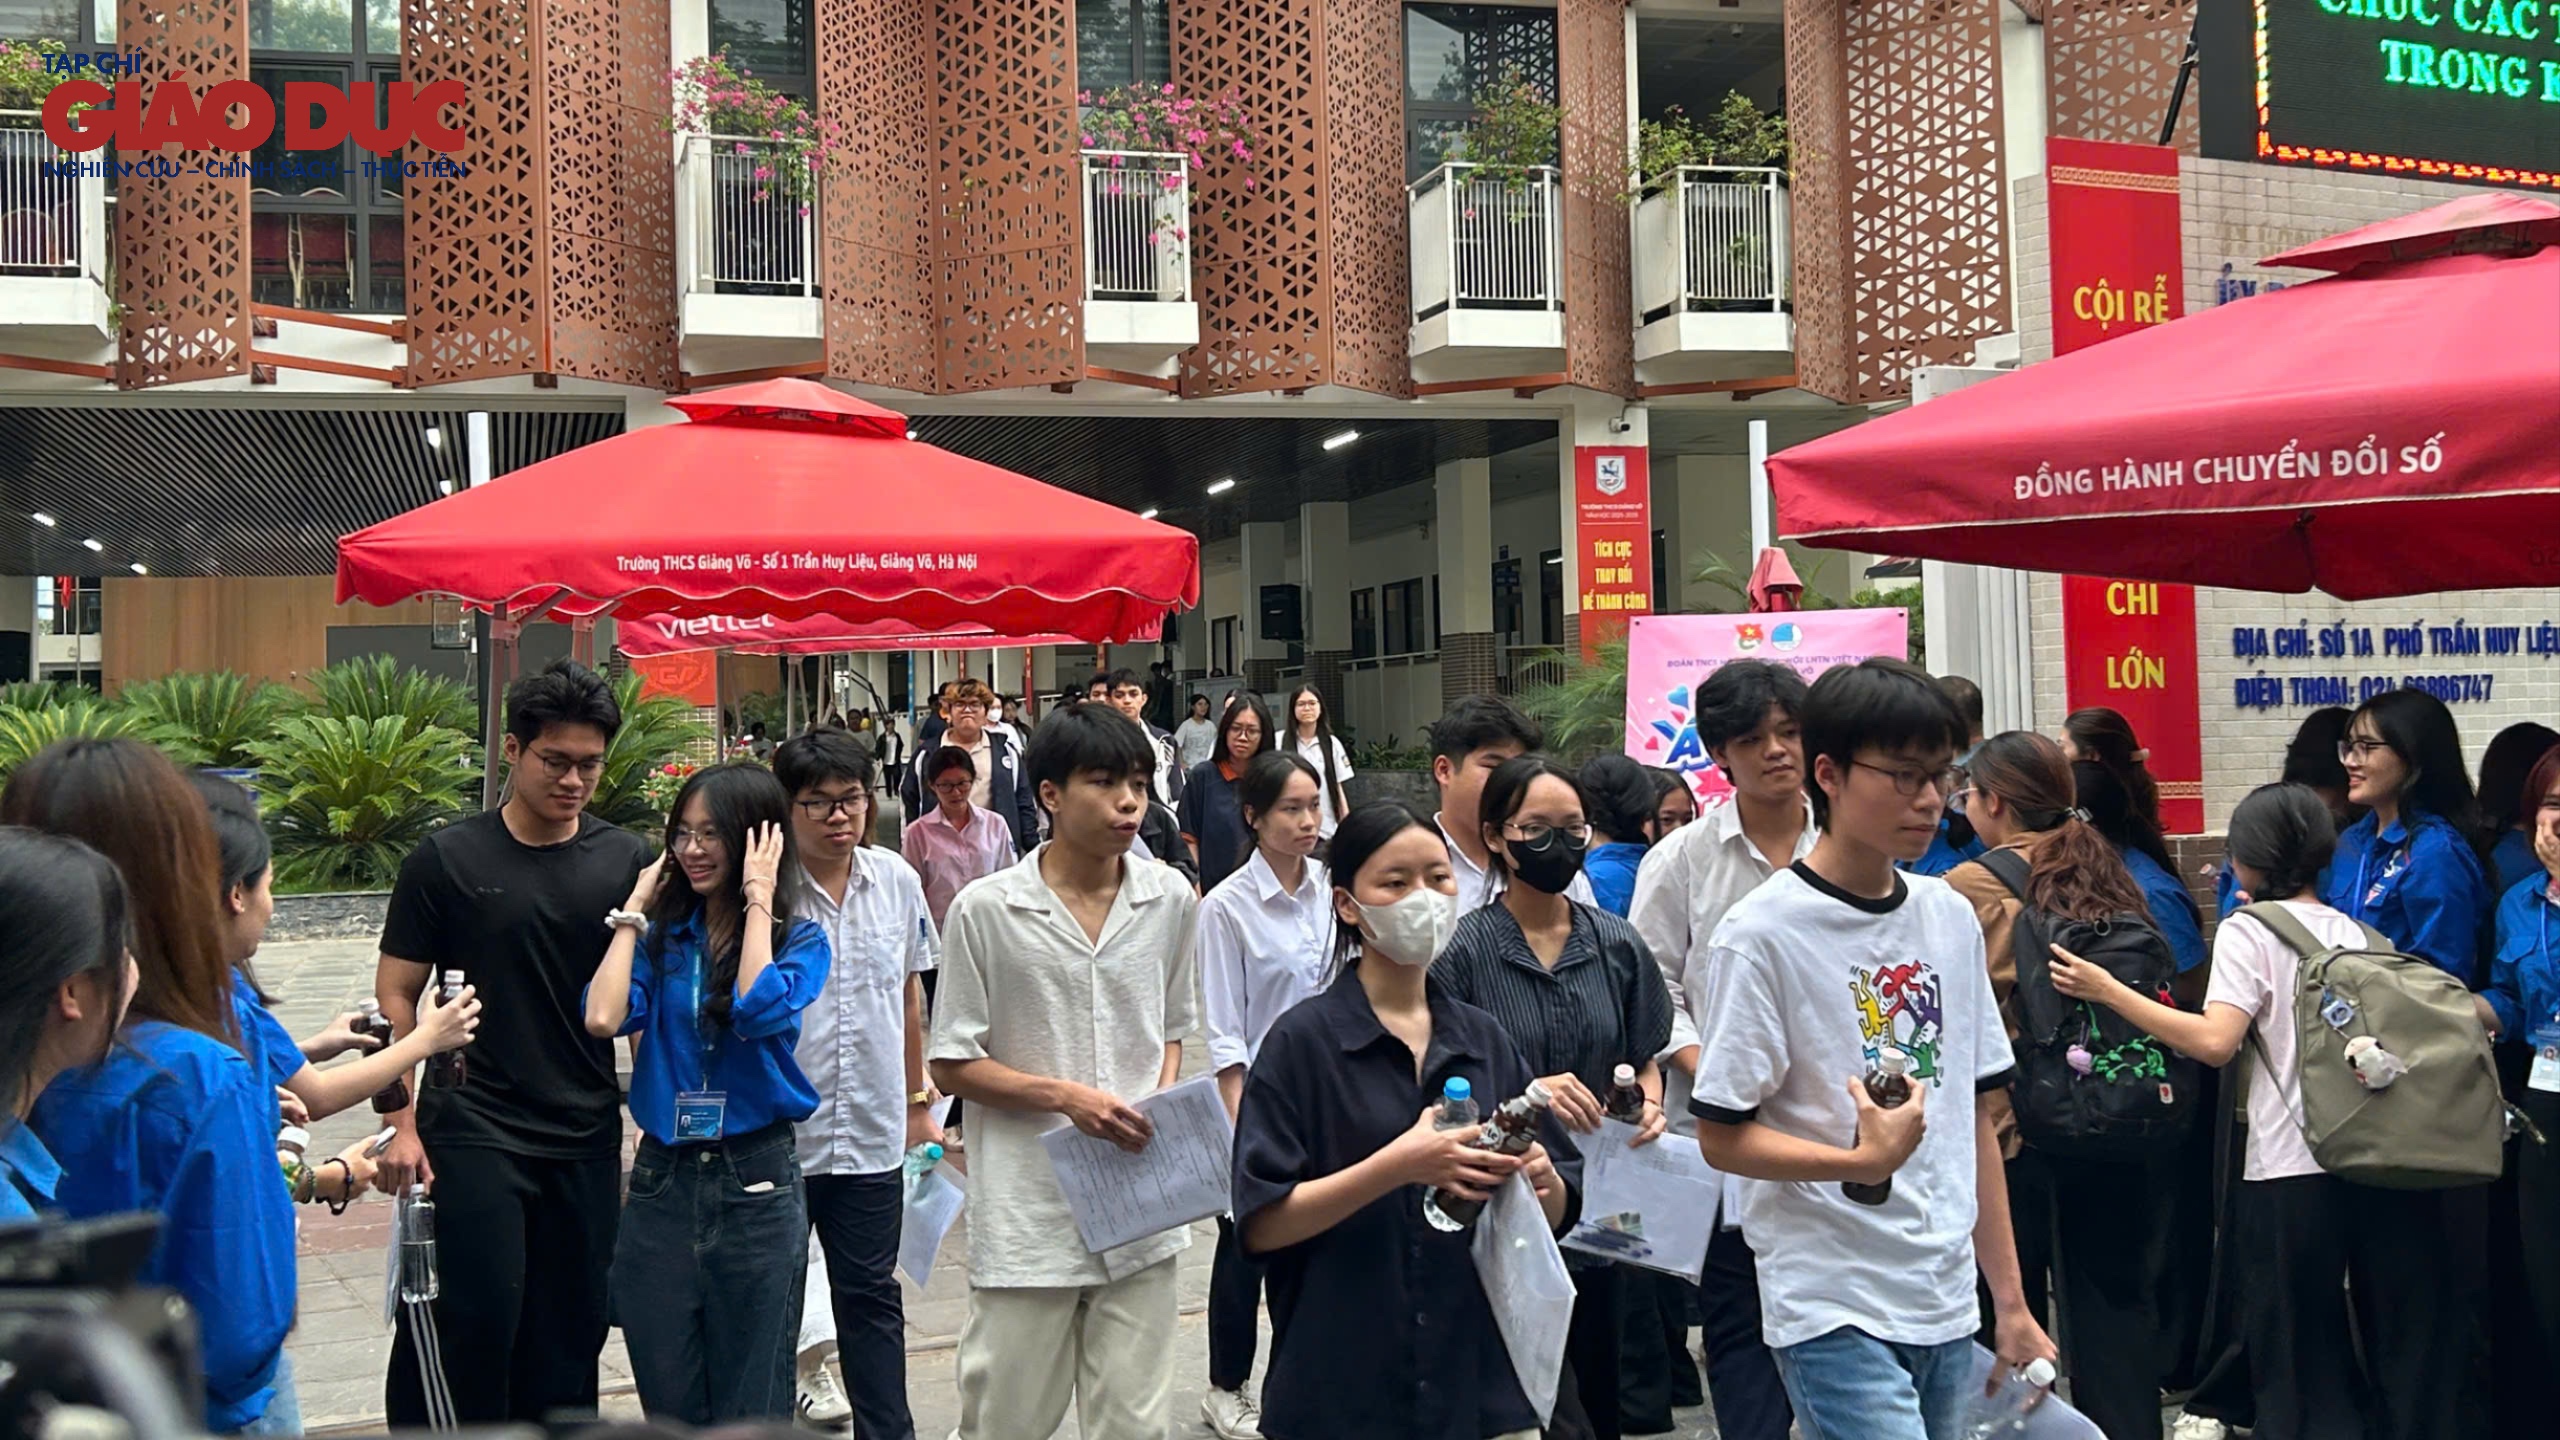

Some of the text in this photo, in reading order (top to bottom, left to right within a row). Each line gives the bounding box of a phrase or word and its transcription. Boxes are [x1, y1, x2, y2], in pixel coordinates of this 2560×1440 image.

[2380, 39, 2532, 97] TRONG
[2073, 273, 2169, 331] CỘI RỄ
[2014, 431, 2446, 500] ĐỒNG HÀNH CHUYỂN ĐỔI SỐ
[616, 555, 660, 575] Trường
[663, 555, 696, 570] THCS
[698, 553, 733, 574] Giảng
[735, 553, 751, 569] Võ
[762, 551, 780, 570] Số
[781, 554, 788, 569] 1
[791, 550, 820, 569] Trần
[822, 553, 846, 573] Huy
[848, 553, 878, 572] Liệu,
[880, 552, 914, 573] Giảng
[917, 553, 936, 571] Võ,
[938, 553, 954, 569] Hà
[957, 553, 978, 572] Nội
[2233, 627, 2269, 666] ĐỊA
[2319, 617, 2346, 658] SỐ
[2349, 627, 2375, 658] 1A
[2383, 618, 2425, 658] PHỐ
[2484, 626, 2520, 656] HUY
[2106, 646, 2166, 690] LỚN
[2235, 669, 2284, 713] ĐIỆN
